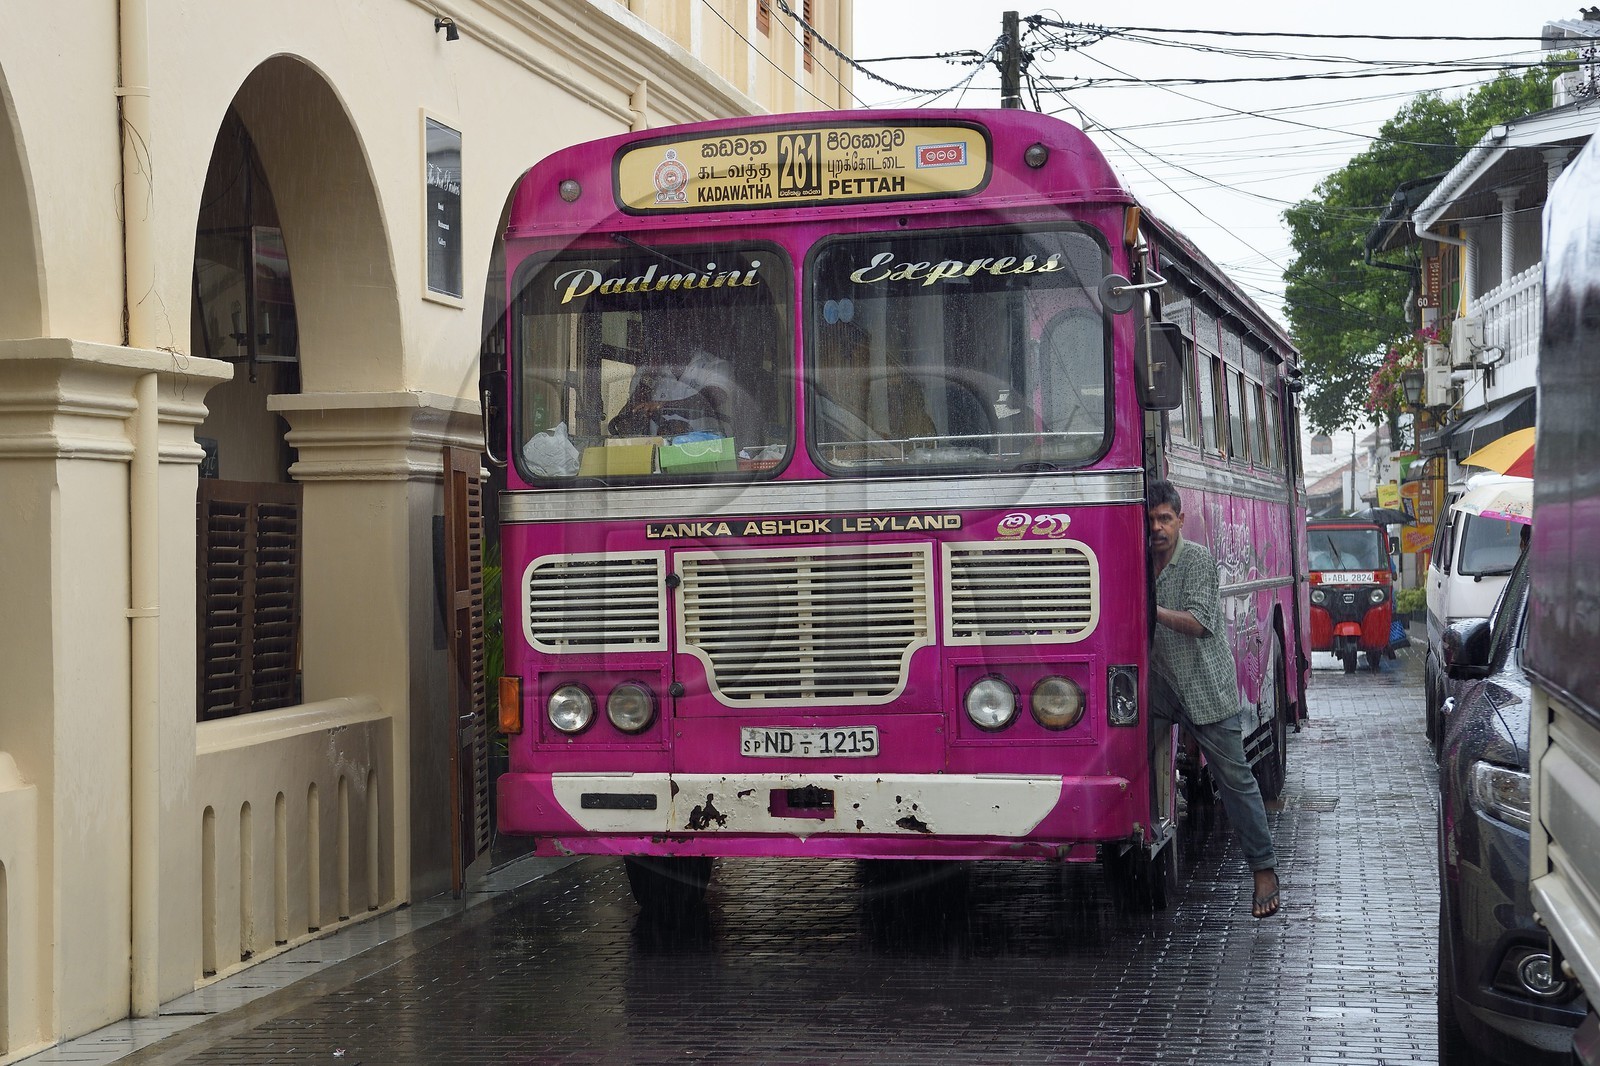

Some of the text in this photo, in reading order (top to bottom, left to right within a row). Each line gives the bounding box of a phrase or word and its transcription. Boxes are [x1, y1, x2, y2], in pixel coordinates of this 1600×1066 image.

[701, 138, 767, 158] කඩවත
[698, 157, 771, 183] கடவத்த
[780, 134, 818, 189] 261
[698, 183, 772, 202] KADAWATHA
[828, 176, 905, 195] PETTAH
[554, 252, 1065, 305] Padmini Express
[1417, 297, 1428, 307] 60
[647, 514, 961, 539] LANKA ASHOK LEYLAND
[1351, 573, 1372, 582] 2824
[744, 740, 761, 753] SP
[764, 731, 793, 753] ND
[819, 730, 875, 753] 1215
